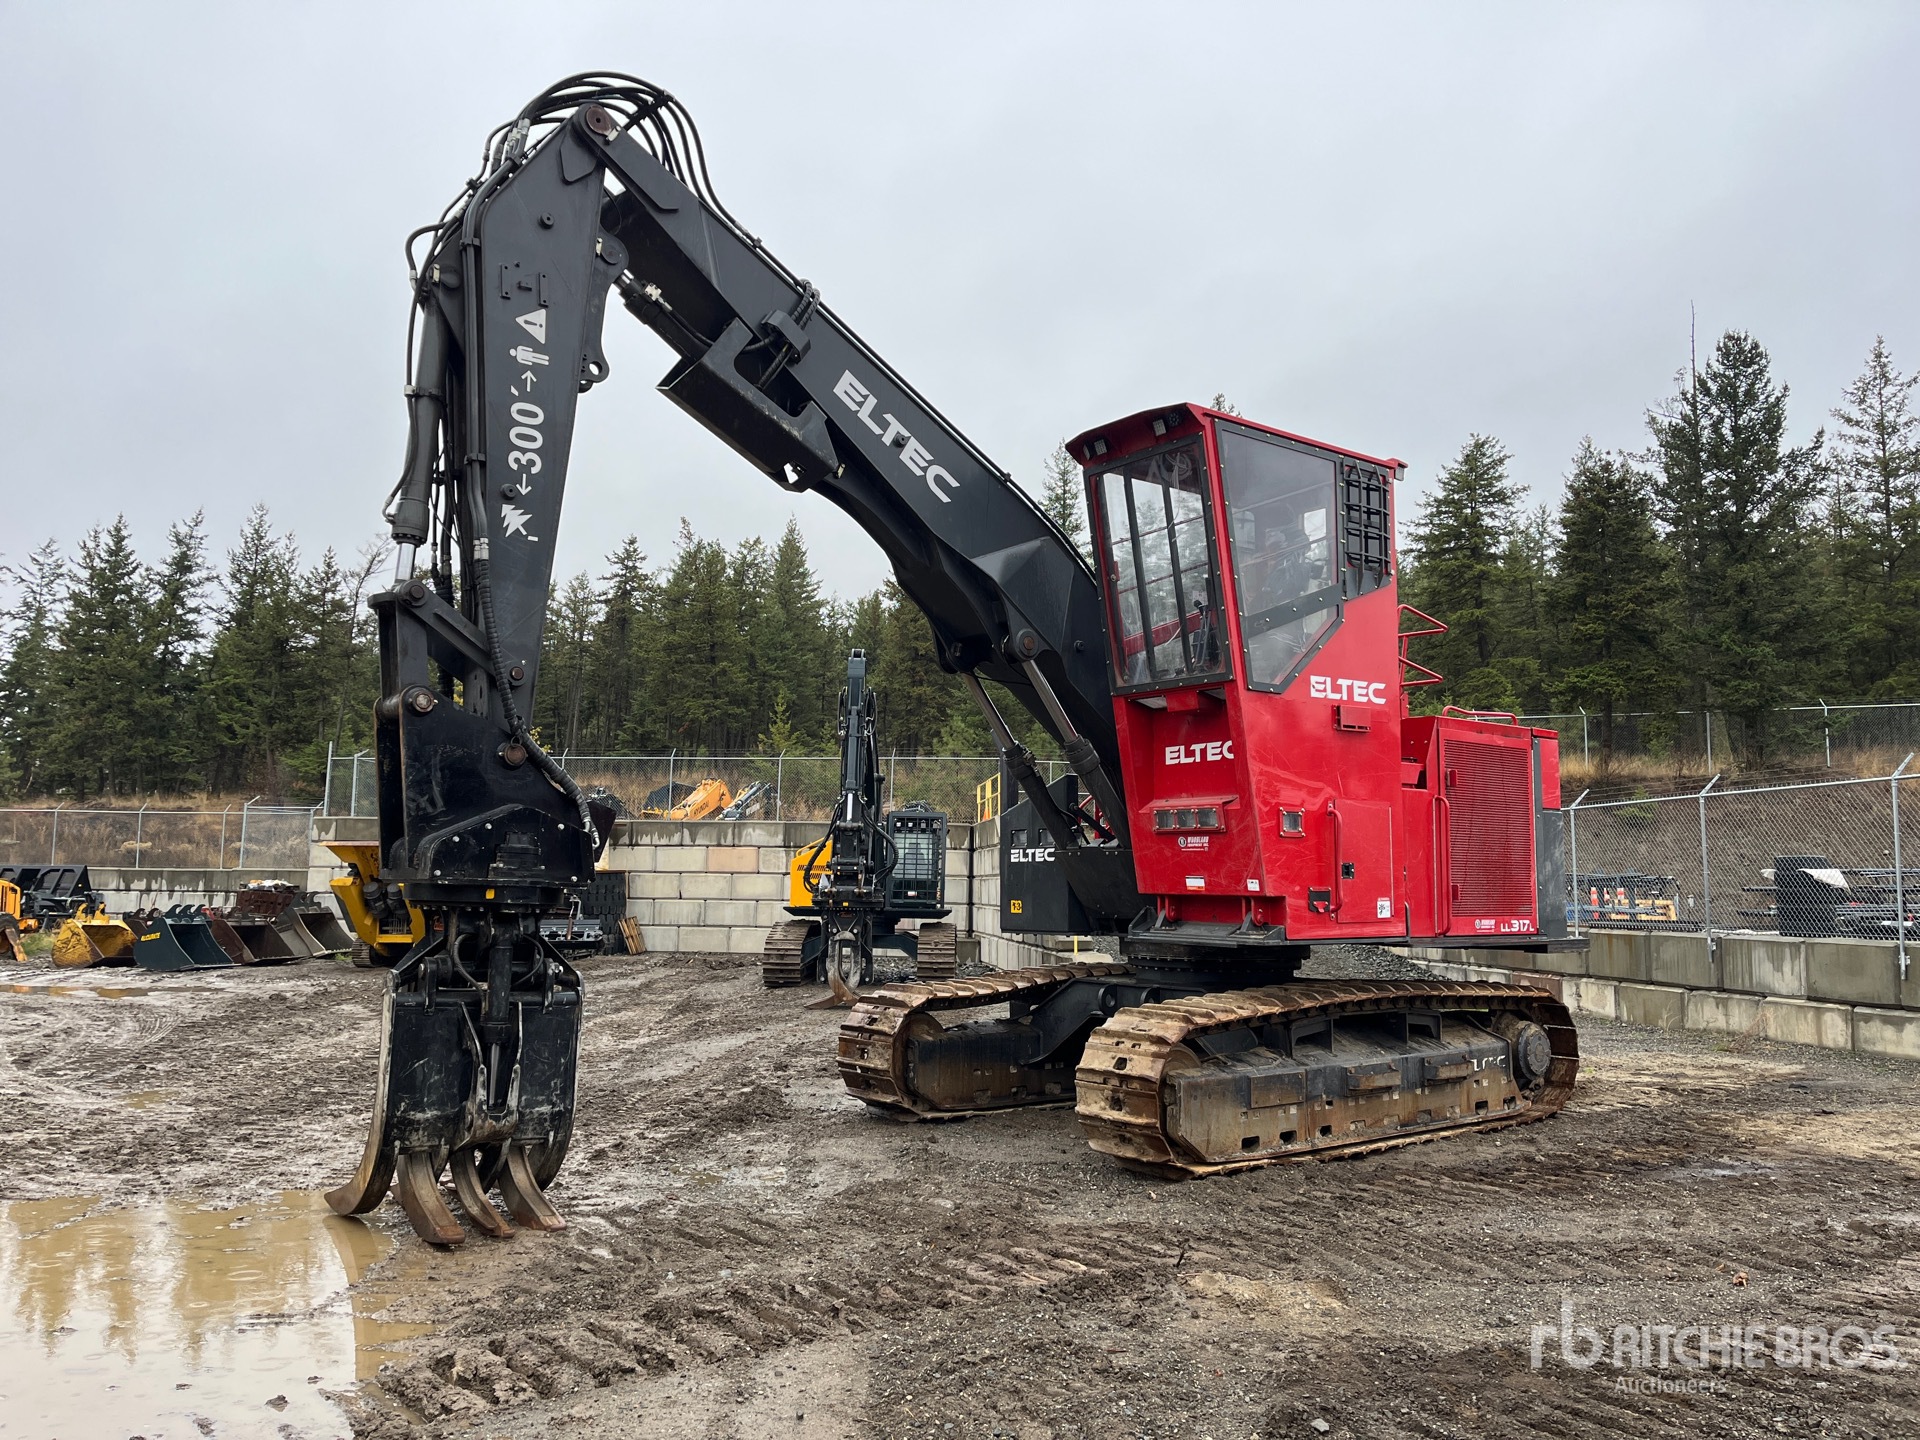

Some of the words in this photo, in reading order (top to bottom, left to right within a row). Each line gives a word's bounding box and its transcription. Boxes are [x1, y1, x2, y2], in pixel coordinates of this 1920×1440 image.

[833, 369, 960, 503] ELTEC
[1310, 675, 1387, 705] ELTEC
[1165, 740, 1235, 766] ELTEC
[1010, 848, 1056, 863] ELTEC
